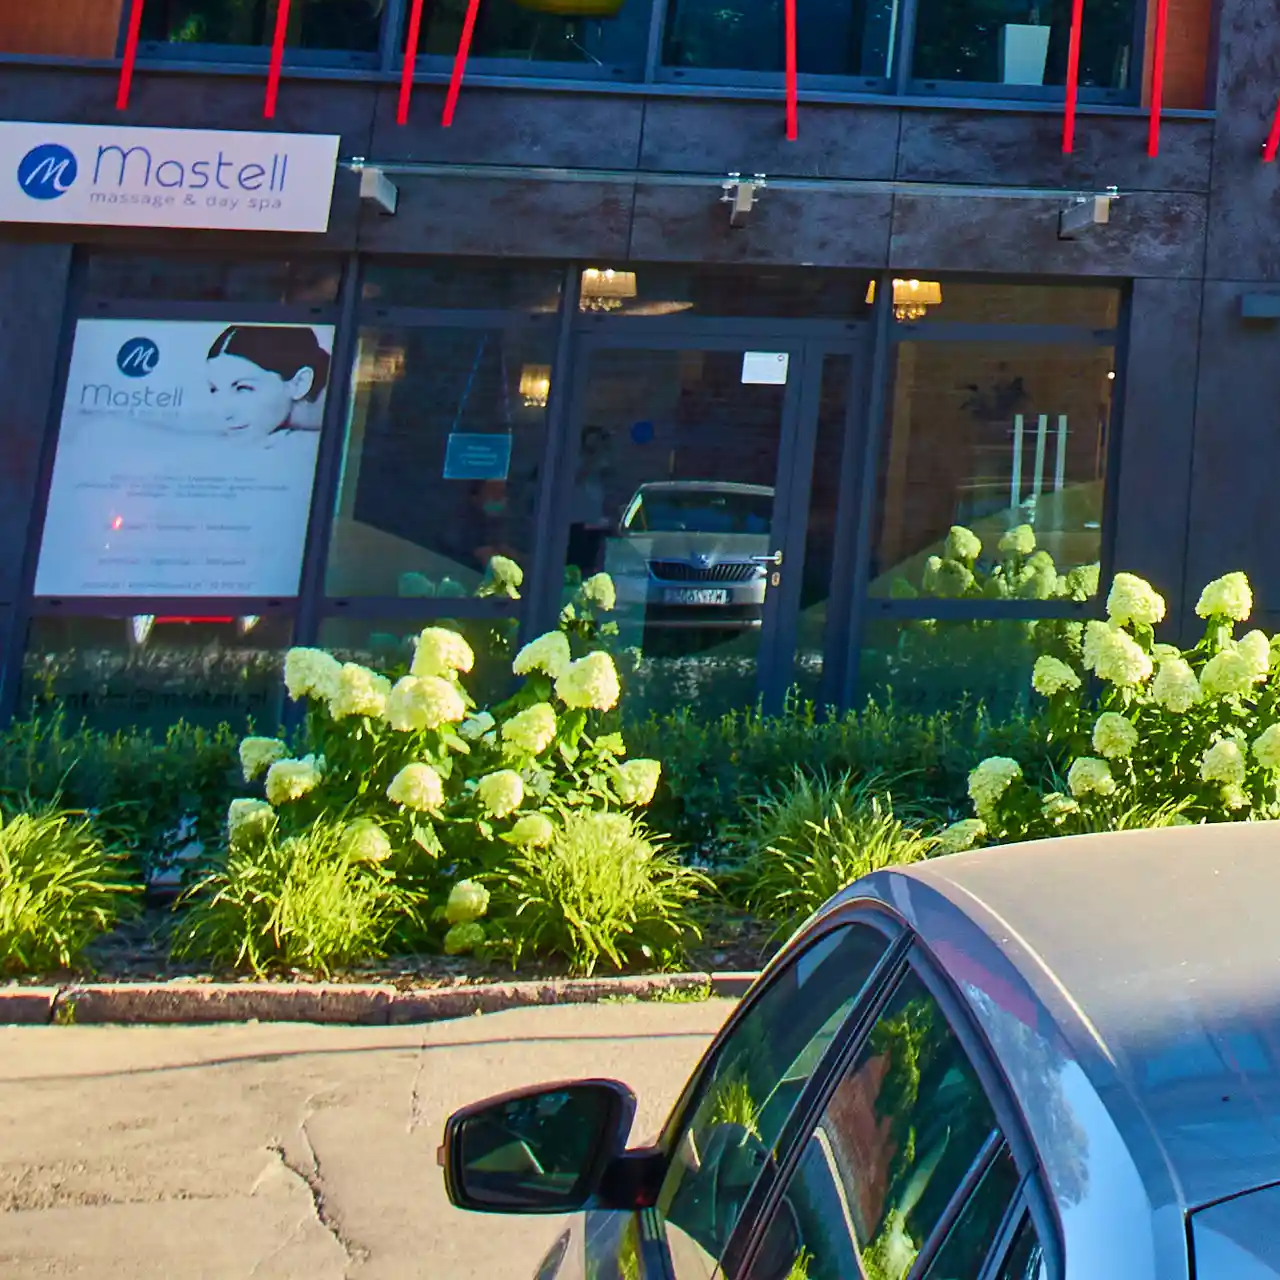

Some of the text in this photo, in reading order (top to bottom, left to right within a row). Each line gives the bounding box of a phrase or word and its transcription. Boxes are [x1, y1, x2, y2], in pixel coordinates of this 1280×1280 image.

[89, 191, 283, 212] massage & day spa
